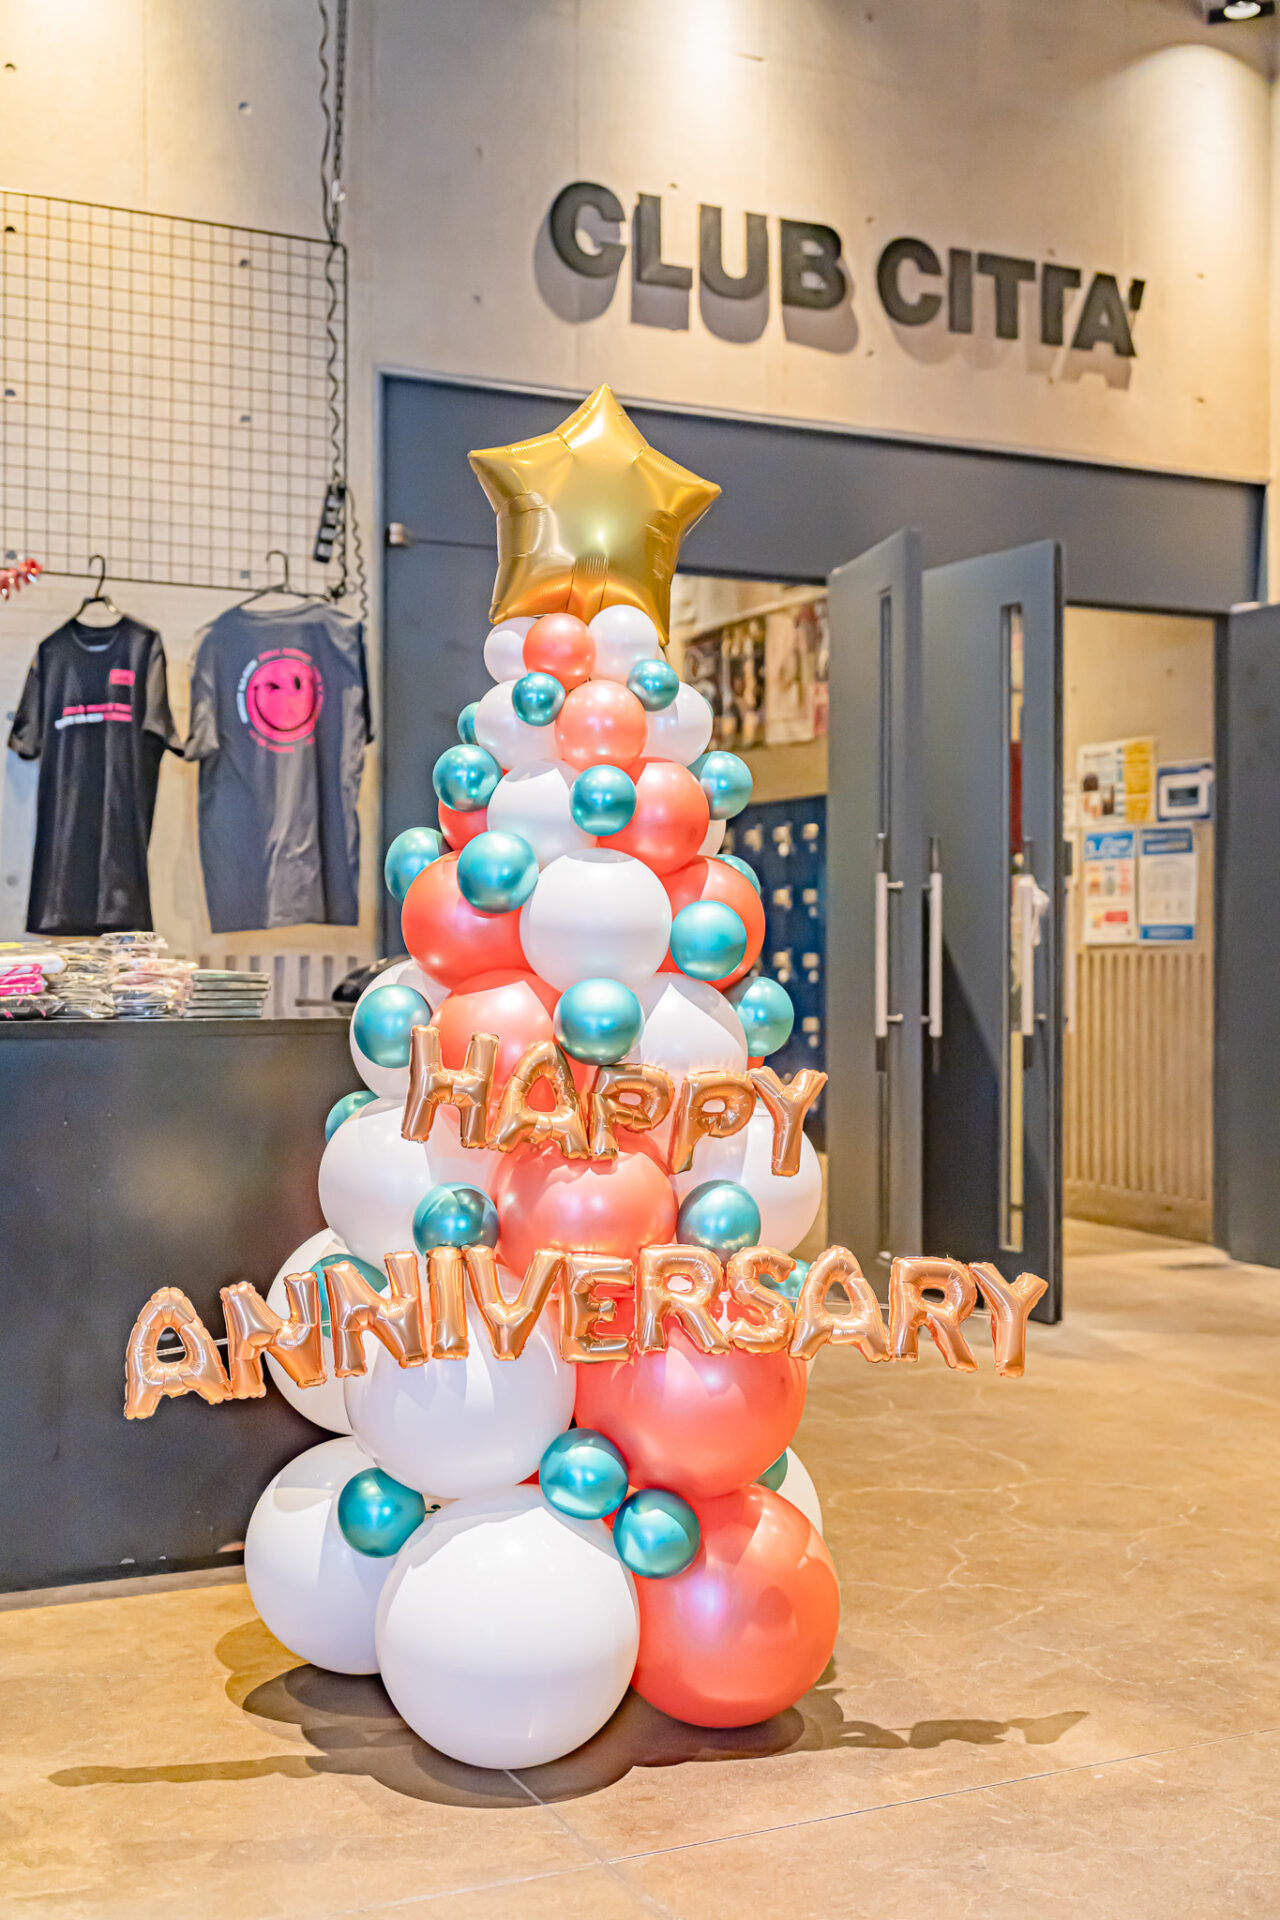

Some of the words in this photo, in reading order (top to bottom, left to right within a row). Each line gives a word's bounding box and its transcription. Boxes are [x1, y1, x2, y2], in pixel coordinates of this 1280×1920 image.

[550, 181, 846, 310] CLUB
[401, 1025, 828, 1177] HAPPY
[124, 1244, 1047, 1420] ANNIVERSARY
